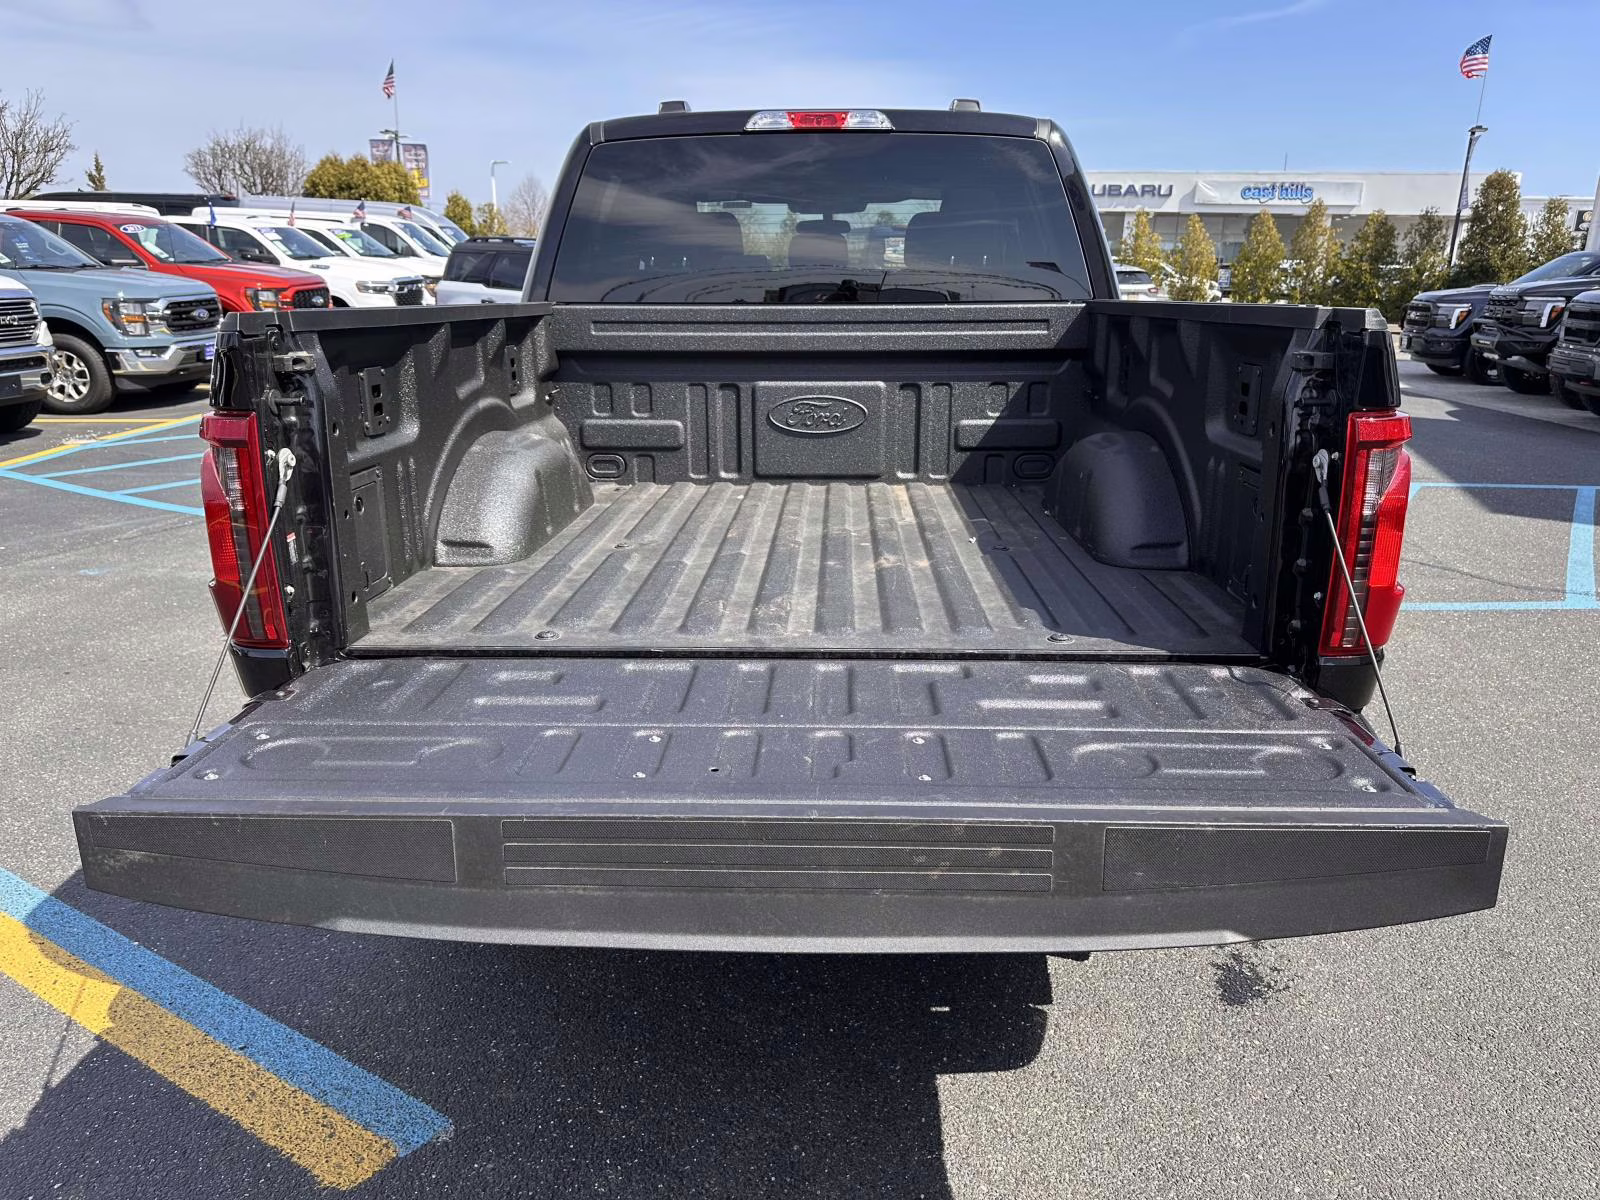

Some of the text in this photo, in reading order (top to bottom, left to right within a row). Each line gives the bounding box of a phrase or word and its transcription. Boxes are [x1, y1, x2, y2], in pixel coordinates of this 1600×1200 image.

[1091, 184, 1173, 197] UBARU
[1241, 182, 1314, 203] east hills
[786, 400, 848, 426] Ford
